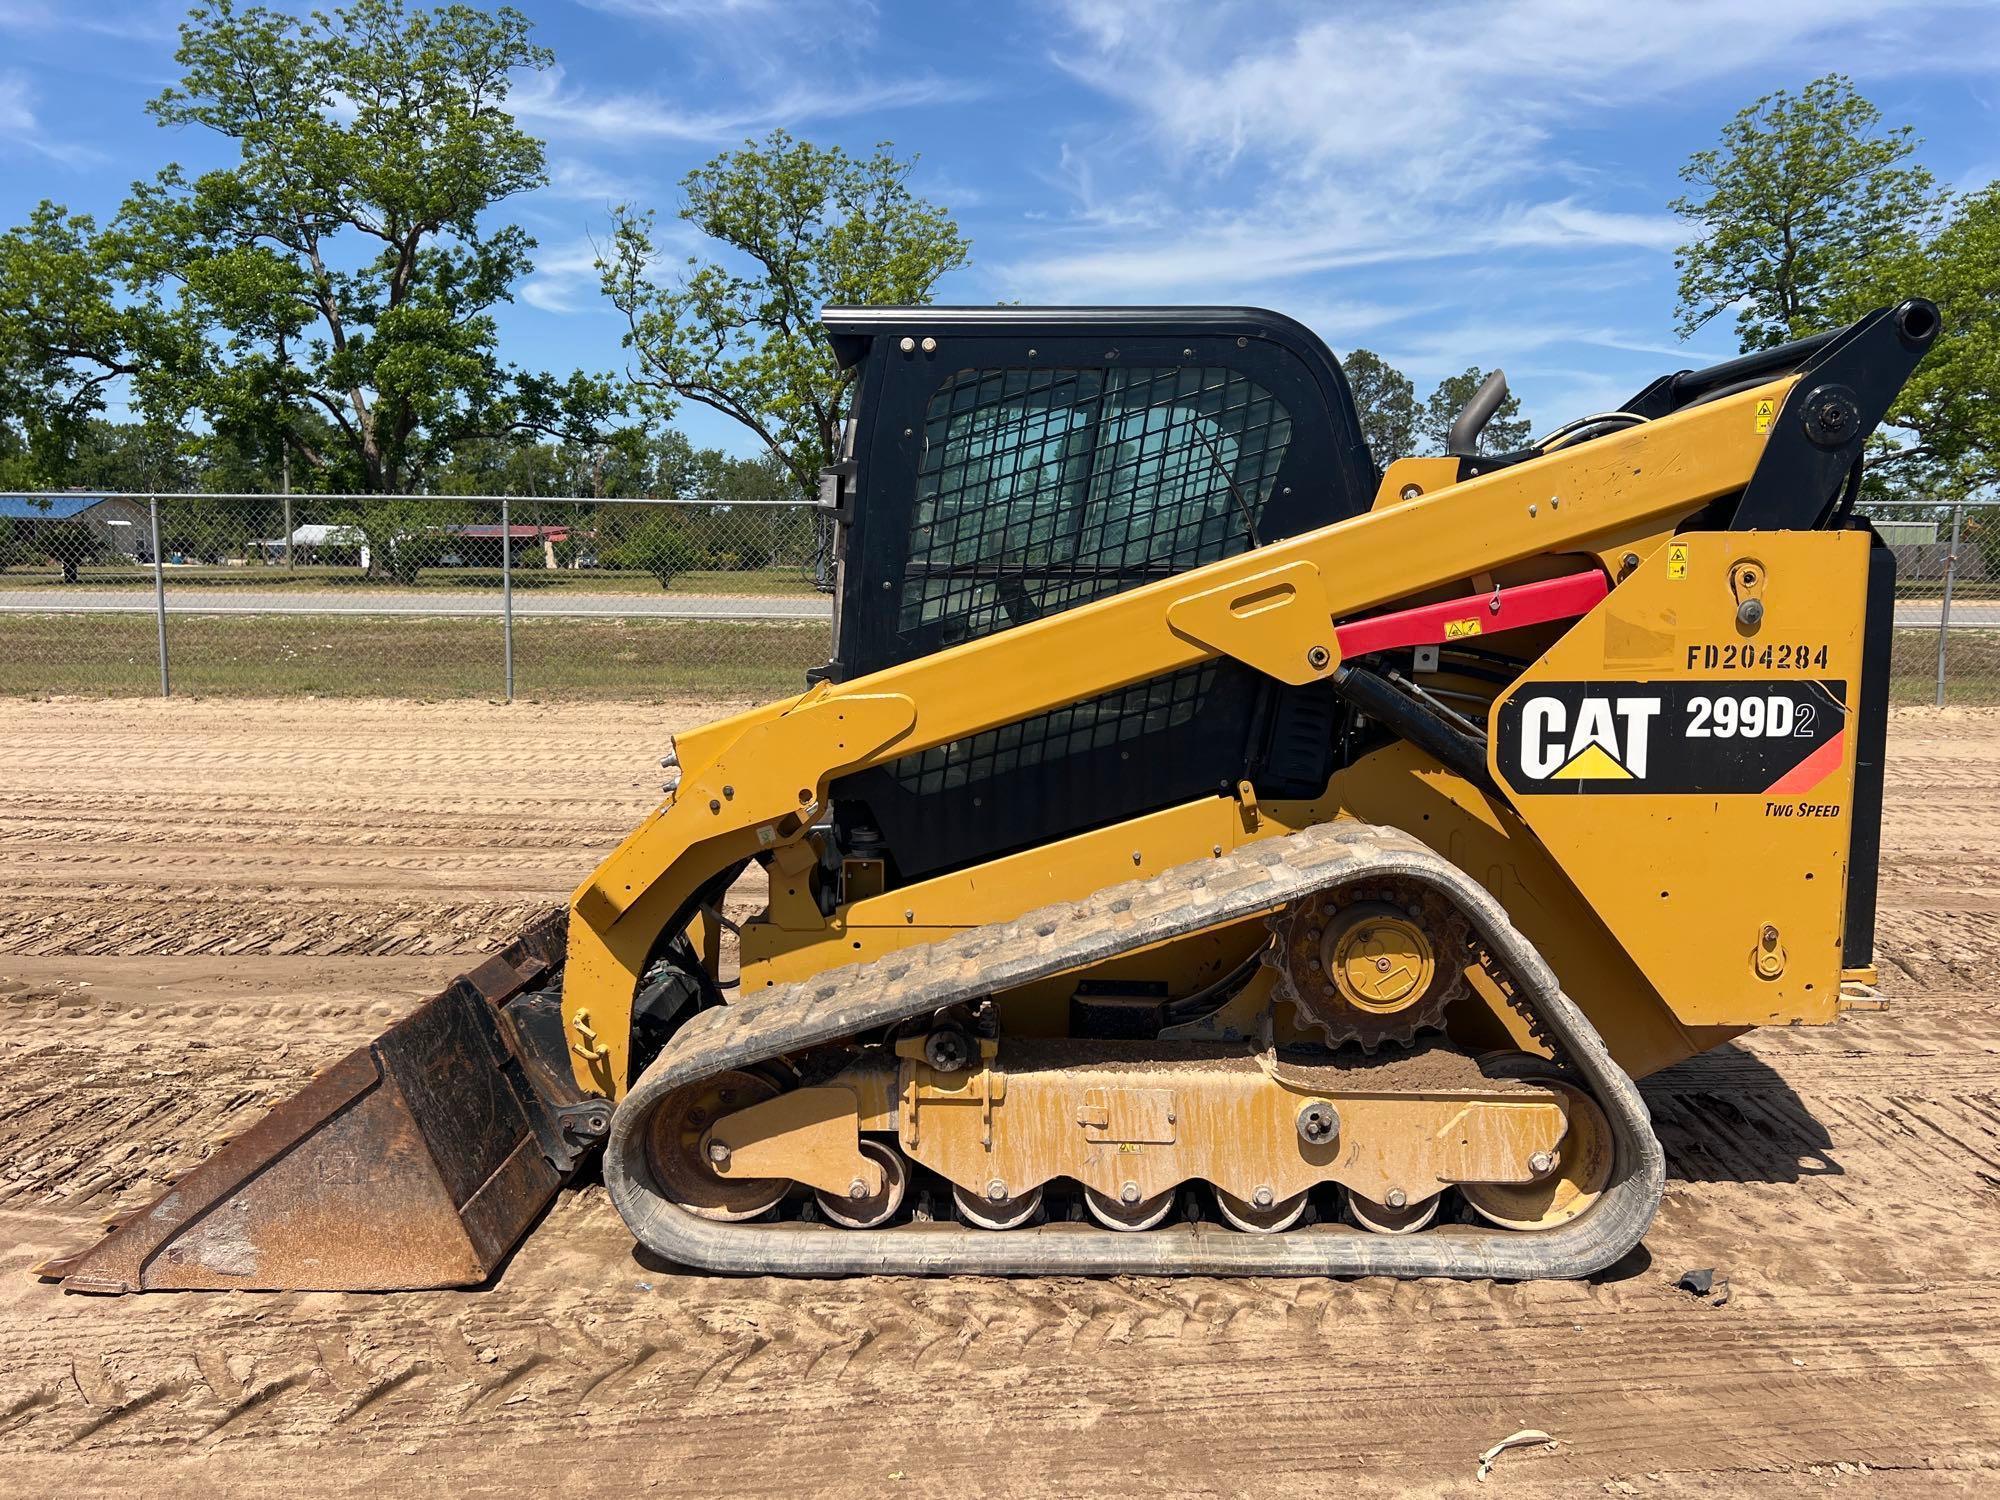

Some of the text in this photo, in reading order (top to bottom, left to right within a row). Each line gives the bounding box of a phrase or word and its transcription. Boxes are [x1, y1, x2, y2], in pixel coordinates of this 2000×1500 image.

[1687, 644, 1828, 670] FD204284
[1520, 696, 1816, 780] CAT 299D2
